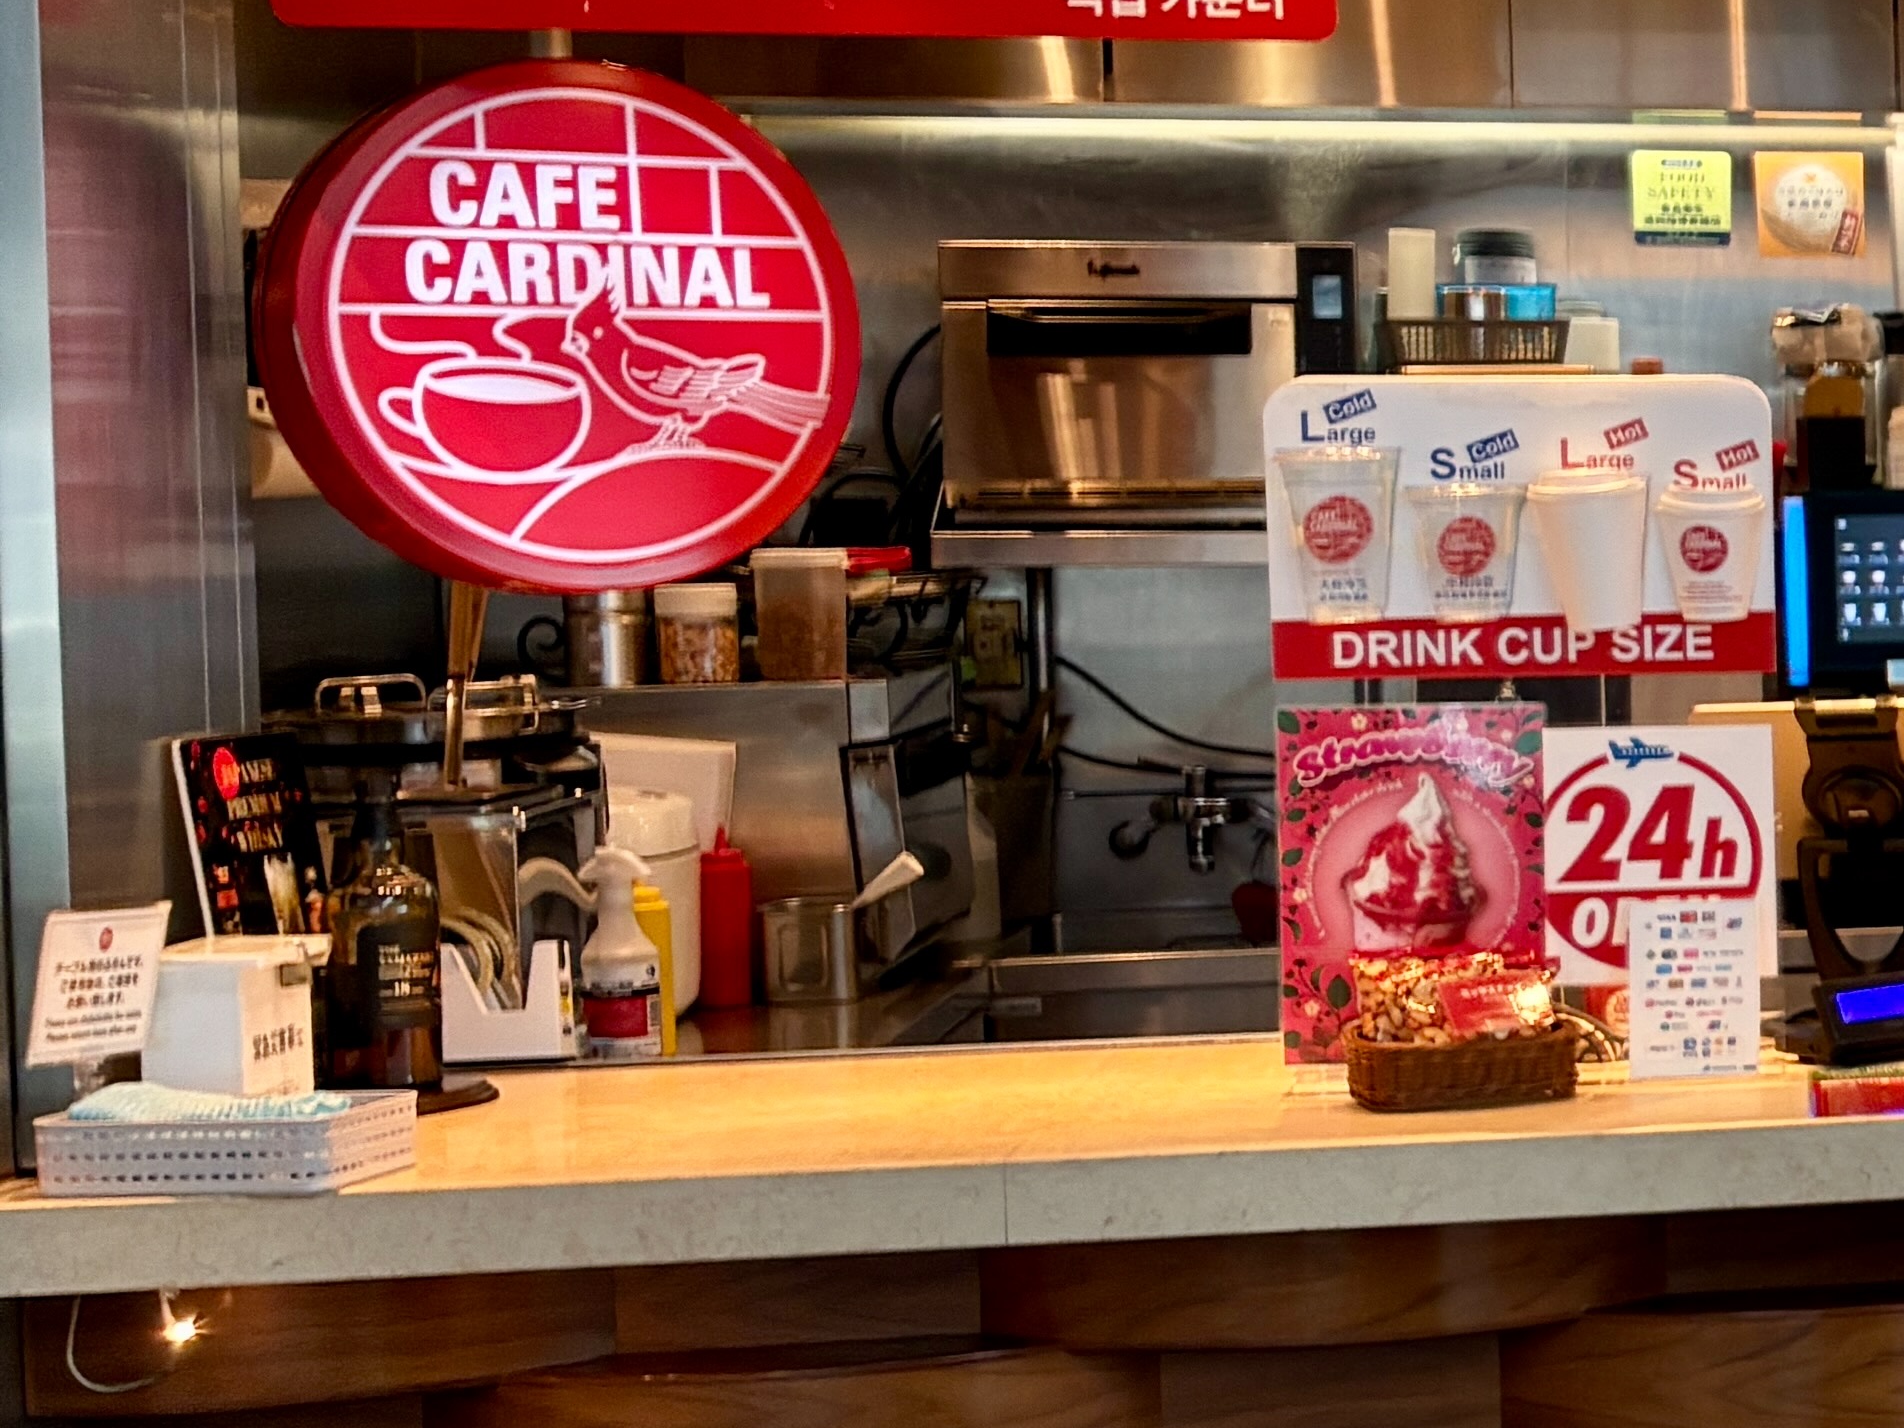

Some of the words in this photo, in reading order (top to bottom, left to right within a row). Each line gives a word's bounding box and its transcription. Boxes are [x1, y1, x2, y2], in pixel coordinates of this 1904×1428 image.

[430, 164, 618, 229] CAFE
[404, 243, 770, 308] CARDINAL
[1300, 410, 1376, 447] Large
[1431, 448, 1505, 480] Small
[1560, 437, 1635, 470] Large
[1332, 629, 1484, 669] DRINK
[1499, 627, 1596, 664] CUP
[1611, 624, 1715, 661] SIZE
[1558, 784, 1740, 883] 24h
